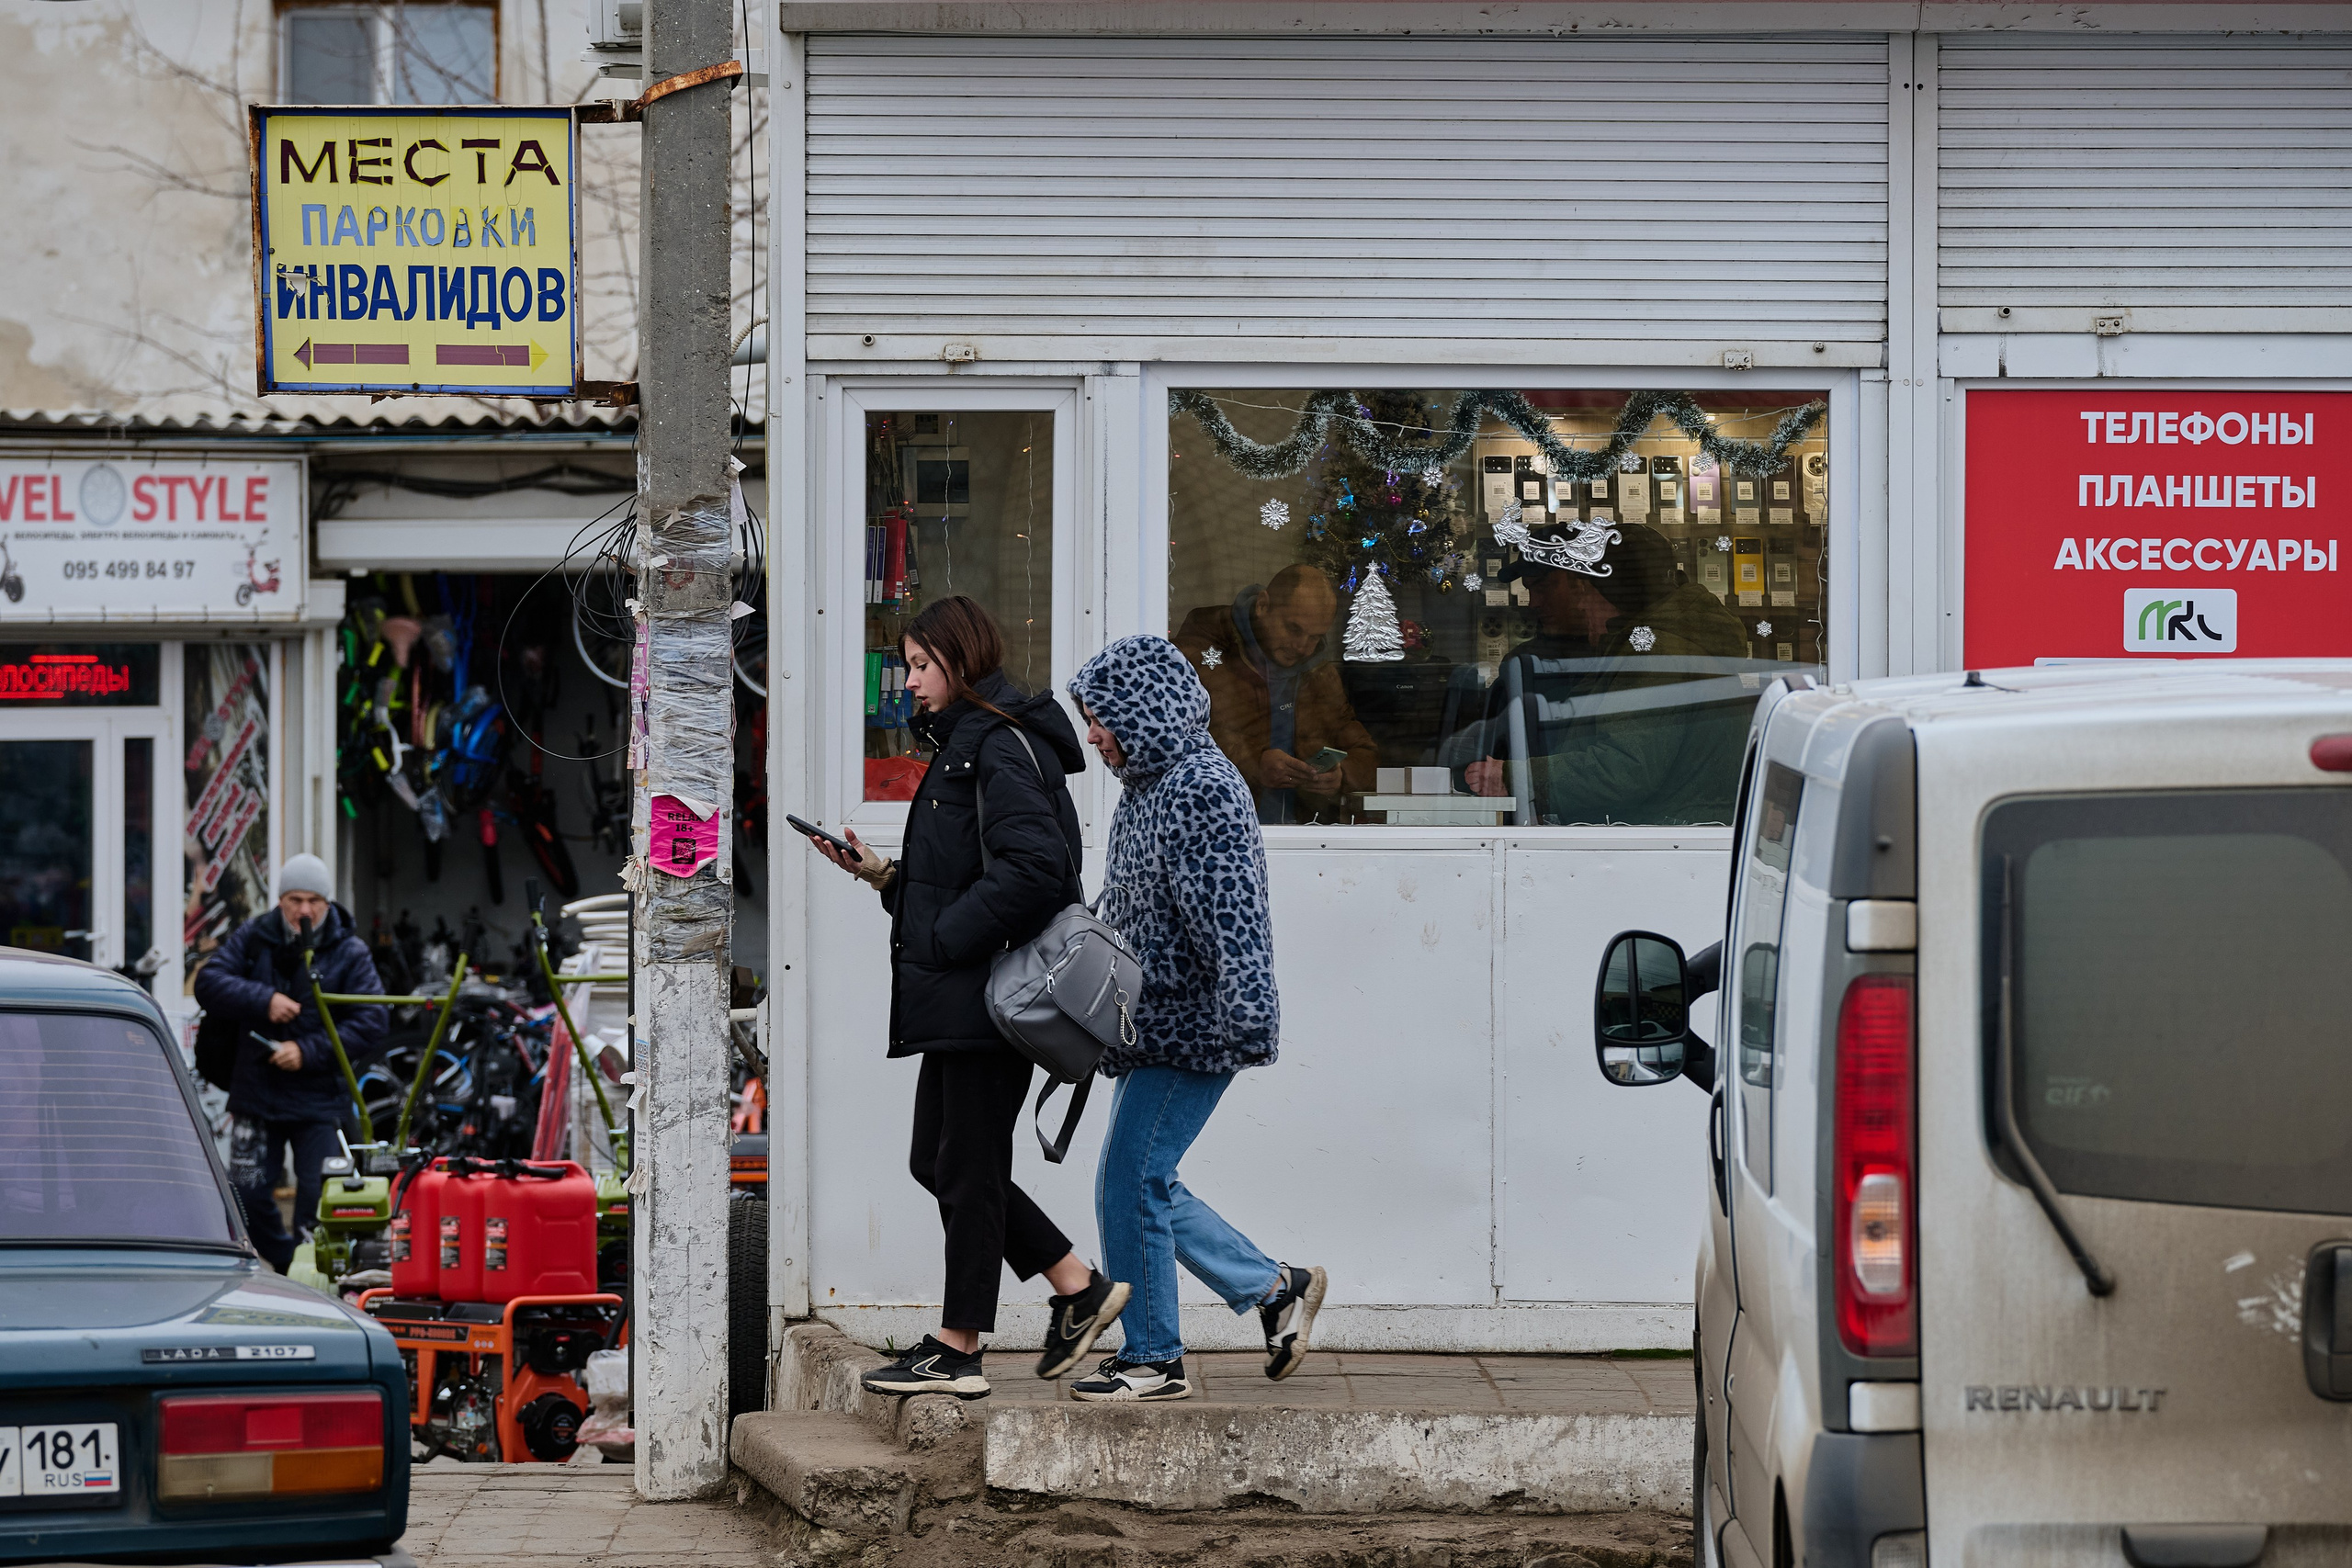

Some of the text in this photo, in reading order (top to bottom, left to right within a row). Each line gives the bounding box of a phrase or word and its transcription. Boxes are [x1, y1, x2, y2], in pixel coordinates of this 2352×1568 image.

[279, 138, 561, 186] МЕСТА
[300, 203, 536, 248] ПАРКОВКИ
[277, 263, 567, 331] ИНВАЛИДОВ
[2080, 411, 2314, 446] ТЕЛЕФОНЫ
[131, 474, 270, 522] STYLE
[2078, 474, 2316, 508] ПЛАНШЕТЫ
[63, 560, 197, 580] 095 499 84 97
[2053, 537, 2338, 572] АКСЕССУАРЫ
[0, 664, 129, 695] лосипеды
[675, 823, 695, 832] 18+
[160, 1348, 220, 1359] LADA
[251, 1347, 299, 1358] 2107
[1964, 1384, 2168, 1413] RENAULT
[27, 1428, 101, 1471] 181
[45, 1472, 83, 1487] RUS
